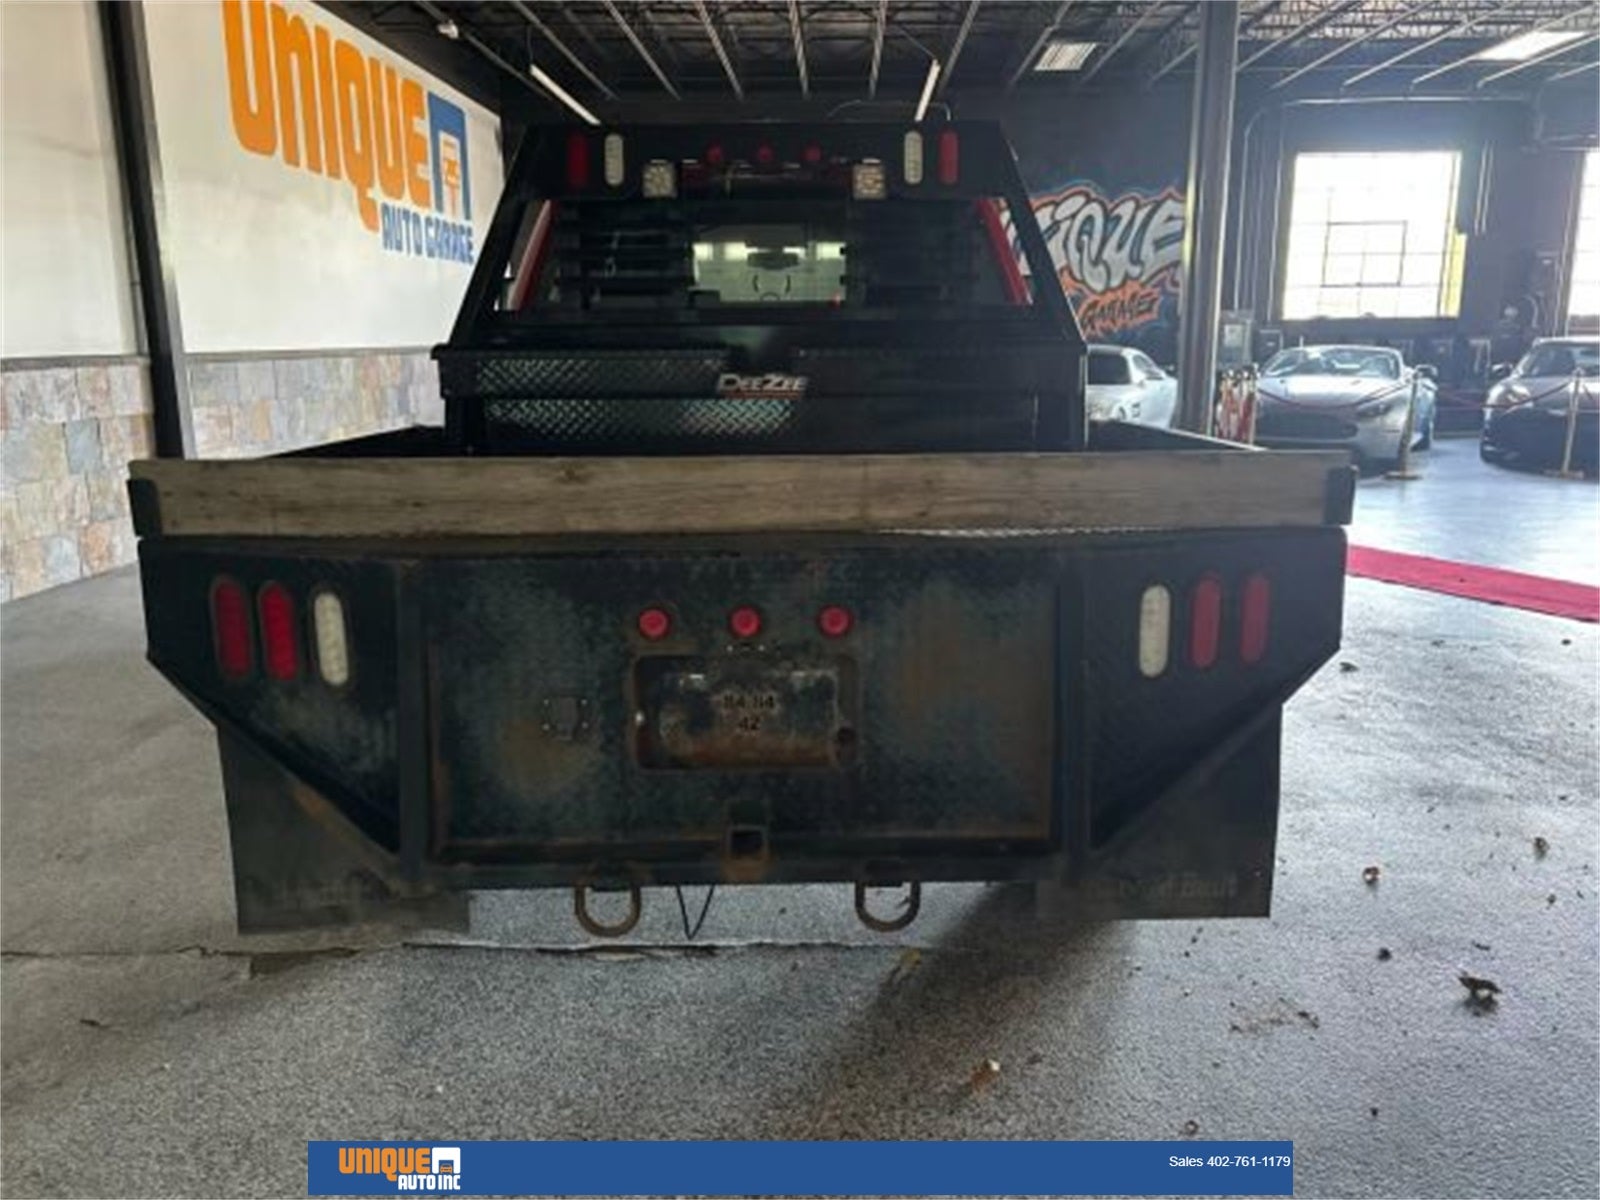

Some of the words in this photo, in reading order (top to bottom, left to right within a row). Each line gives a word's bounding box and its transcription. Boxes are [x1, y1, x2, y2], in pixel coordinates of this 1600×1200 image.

[222, 0, 431, 233] UNIQUE
[381, 202, 422, 255] AUTO
[424, 215, 474, 266] GARAGE
